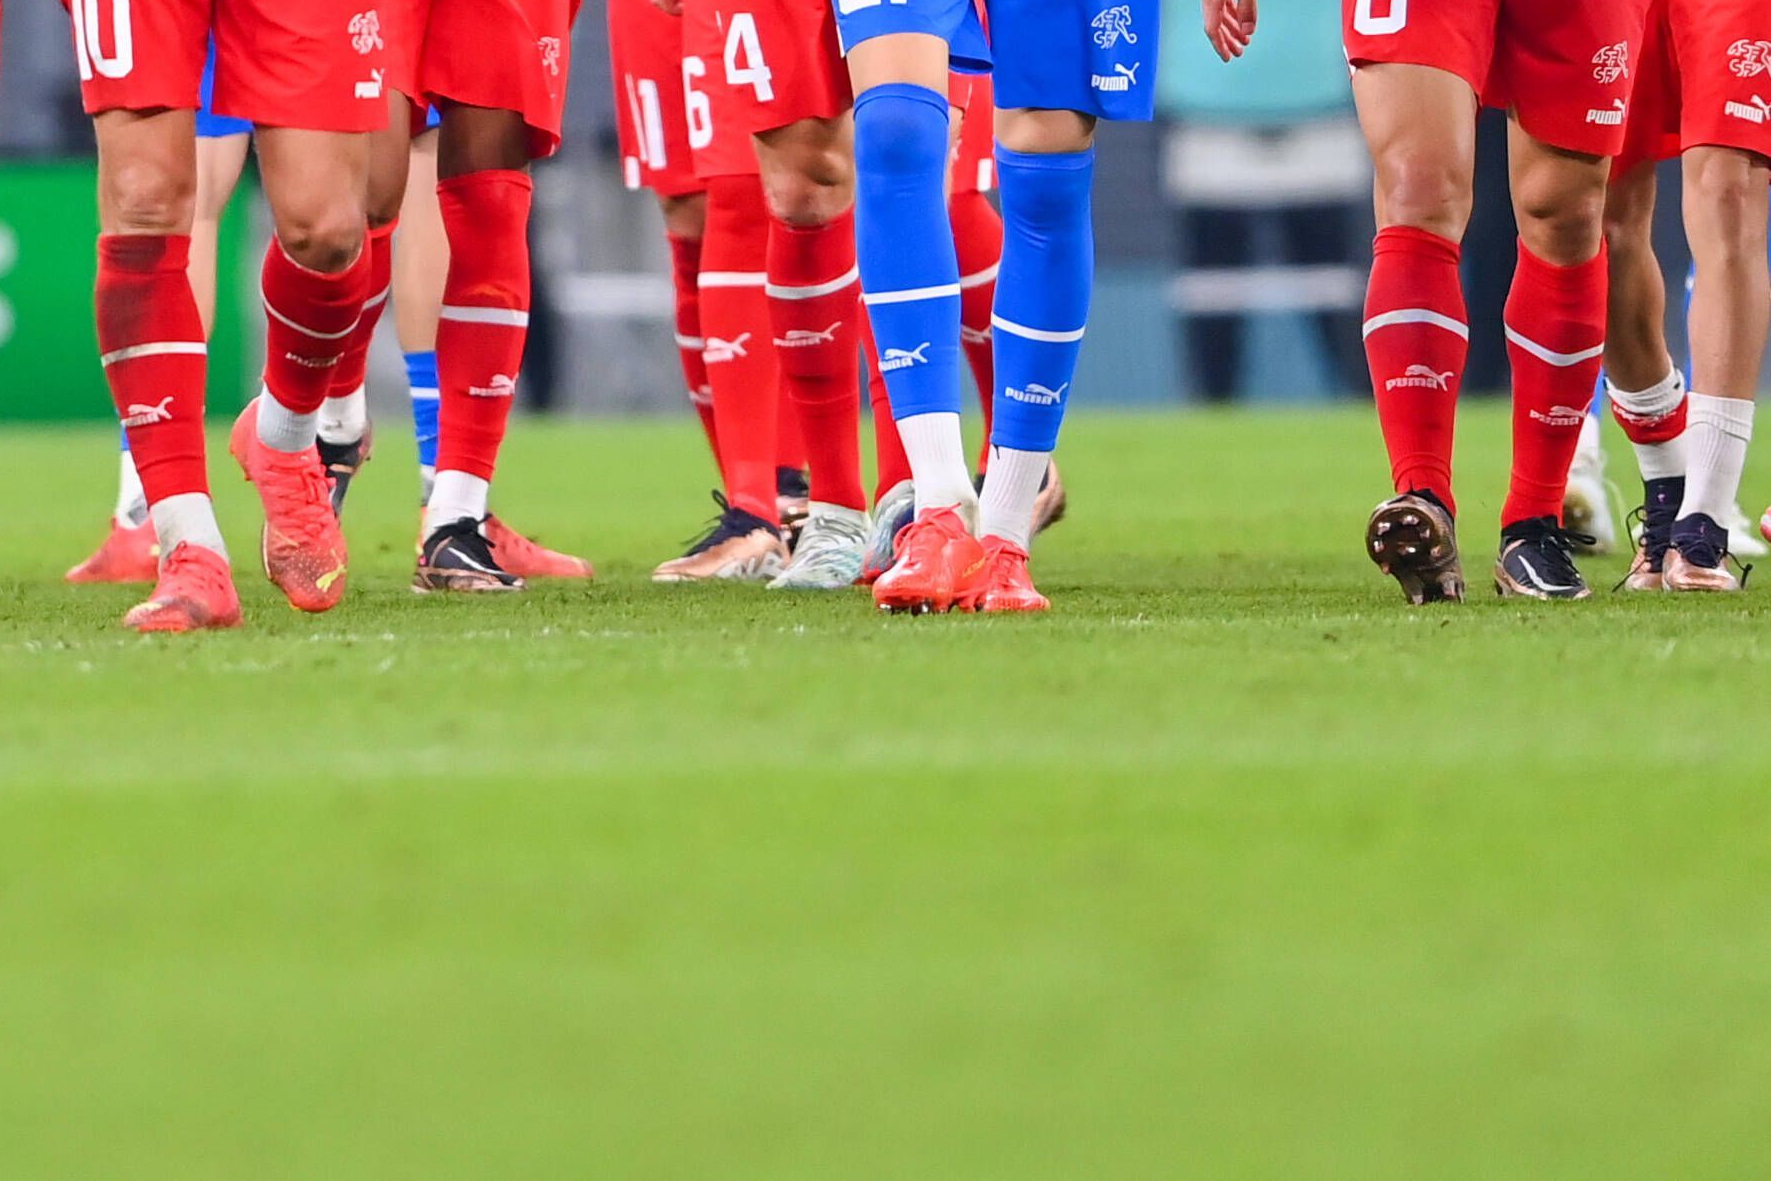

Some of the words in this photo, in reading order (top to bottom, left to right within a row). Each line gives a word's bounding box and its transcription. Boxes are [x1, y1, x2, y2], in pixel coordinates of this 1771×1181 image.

[715, 10, 774, 102] 4
[1091, 74, 1128, 91] PUMA
[1586, 109, 1622, 125] PUMA
[1724, 100, 1763, 124] PUMA
[1386, 377, 1437, 392] PUMA
[1004, 386, 1053, 406] PUMA
